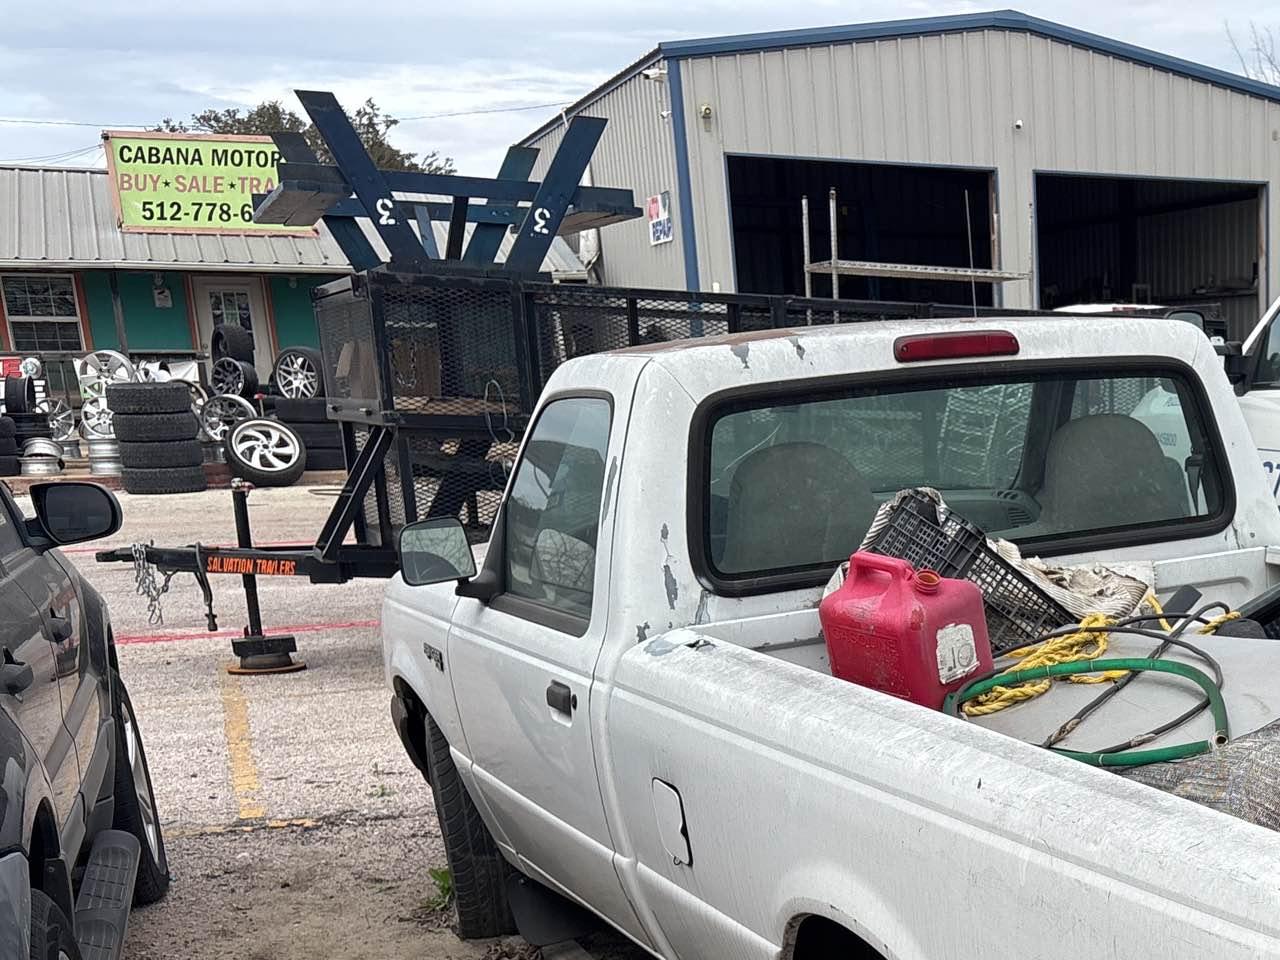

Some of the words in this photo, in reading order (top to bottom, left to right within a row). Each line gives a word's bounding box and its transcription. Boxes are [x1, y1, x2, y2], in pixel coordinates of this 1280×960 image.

[119, 145, 203, 166] CABANA
[119, 173, 161, 192] BUY
[175, 175, 225, 194] SALE
[207, 556, 254, 573] SALVATION
[256, 558, 296, 576] TRAILERS
